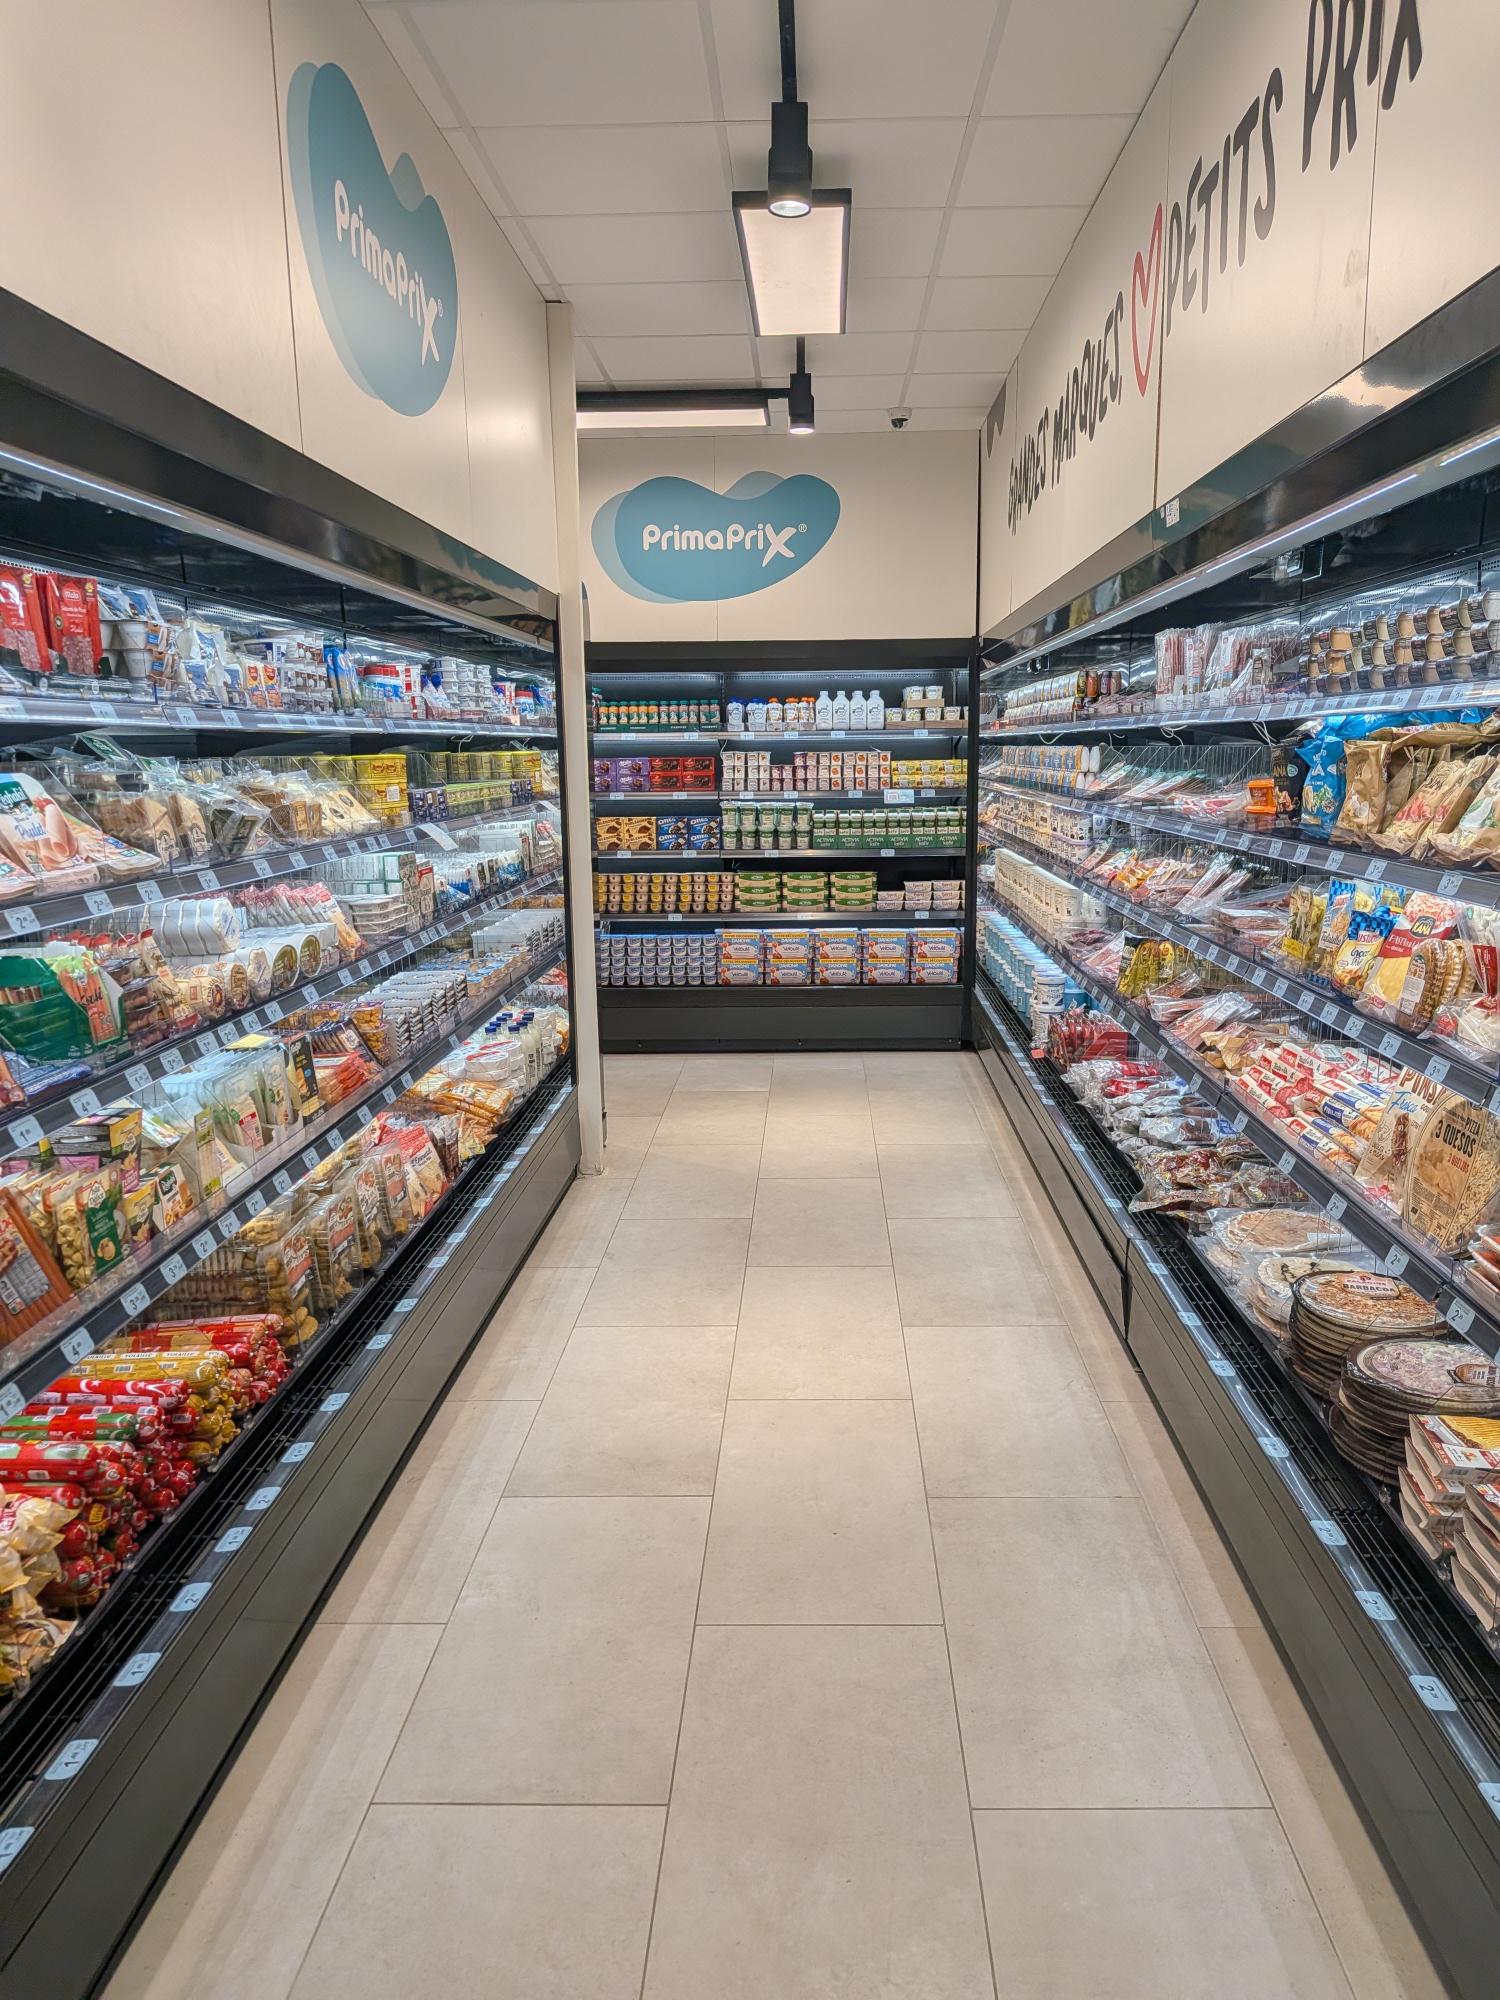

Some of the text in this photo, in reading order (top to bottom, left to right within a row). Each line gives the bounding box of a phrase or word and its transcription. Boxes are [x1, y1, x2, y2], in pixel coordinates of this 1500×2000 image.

[1008, 406, 1049, 536] GRANDES
[1165, 67, 1284, 338] PETITS
[14, 822, 48, 840] Poulet
[1388, 1091, 1419, 1114] Fresca
[1464, 1116, 1481, 1138] PIZZA
[1435, 1119, 1477, 1158] 3 QUESOS
[1342, 1283, 1396, 1293] BARBACOA
